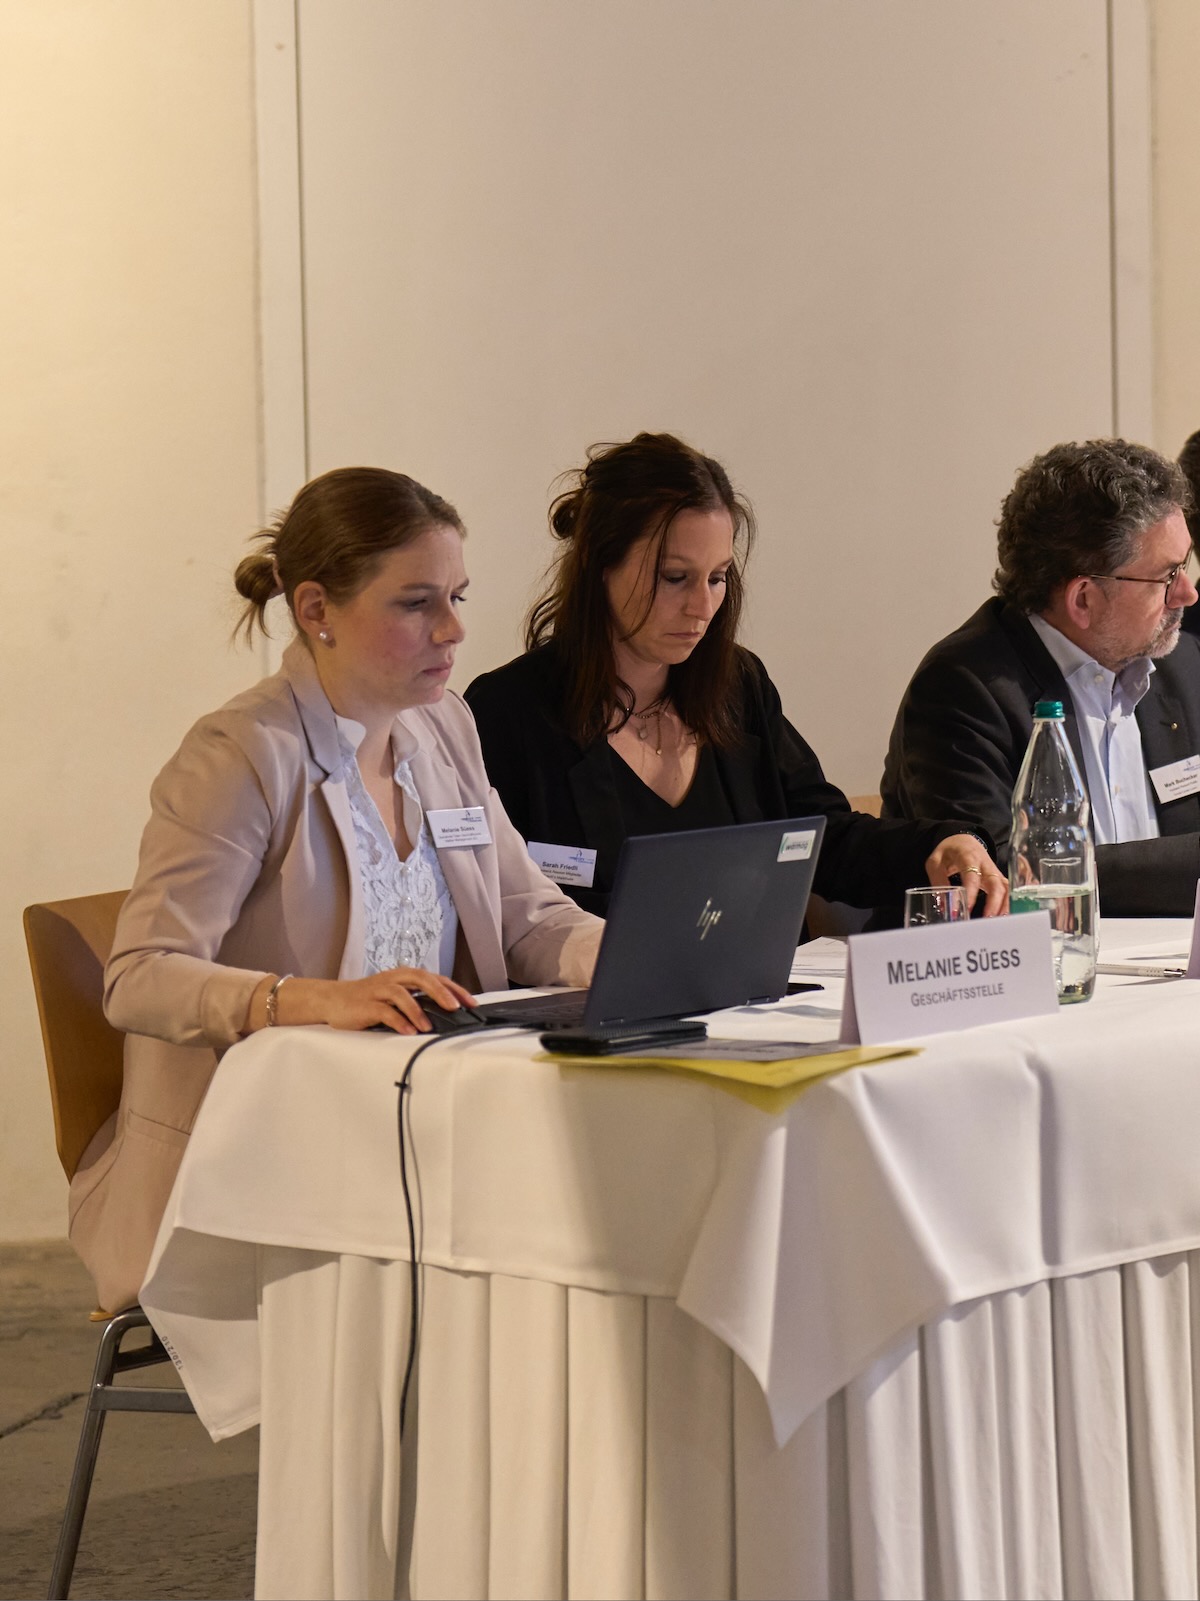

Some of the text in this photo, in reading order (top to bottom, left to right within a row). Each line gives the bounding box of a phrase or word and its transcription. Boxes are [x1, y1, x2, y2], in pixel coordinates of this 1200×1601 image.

[542, 861, 559, 869] Sarah
[560, 863, 579, 871] Friedli
[887, 948, 1021, 985] MELANIE SÜESS
[911, 982, 1004, 1007] GESCHÄFTSSTELLE
[161, 1336, 183, 1370] 130/210
